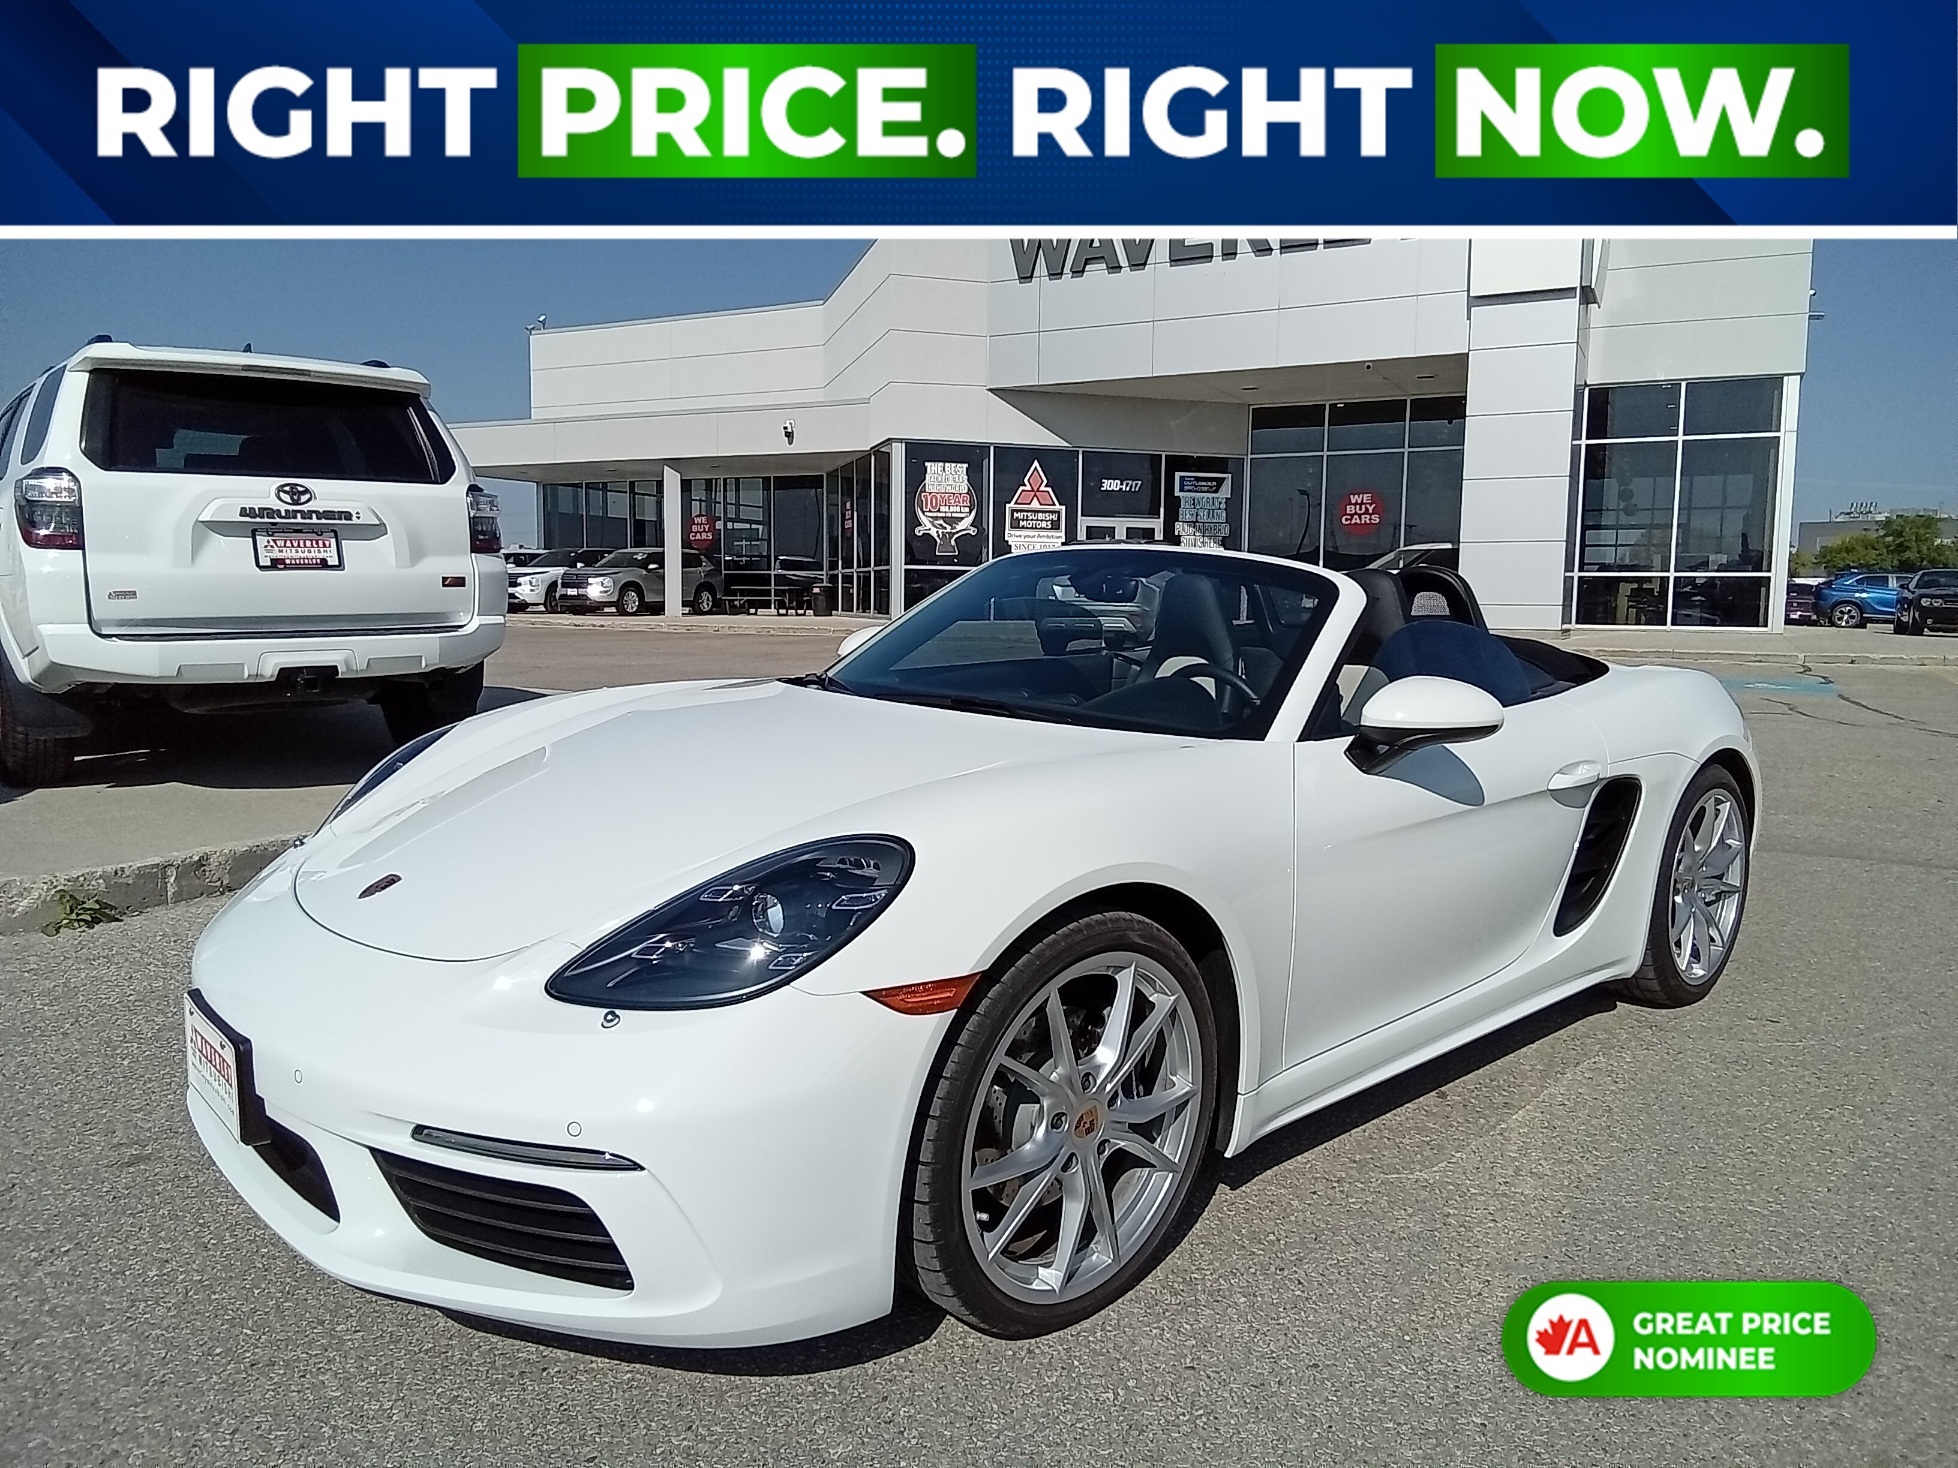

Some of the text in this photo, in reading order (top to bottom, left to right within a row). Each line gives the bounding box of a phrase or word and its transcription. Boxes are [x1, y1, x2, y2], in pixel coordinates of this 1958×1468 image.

[925, 462, 968, 476] THE BEST
[1100, 479, 1142, 491] 300-1717
[922, 493, 970, 512] 10 YEAR
[1350, 494, 1372, 503] WE
[1346, 504, 1376, 514] BUY
[1013, 512, 1058, 520] MITSUBISHI
[1179, 509, 1197, 521] BEST
[1341, 514, 1380, 525] CARS
[694, 516, 707, 524] WE
[1020, 520, 1052, 528] MOTORS
[692, 524, 710, 532] BUY
[690, 532, 713, 541] CARS
[275, 539, 331, 548] WAVERLEY
